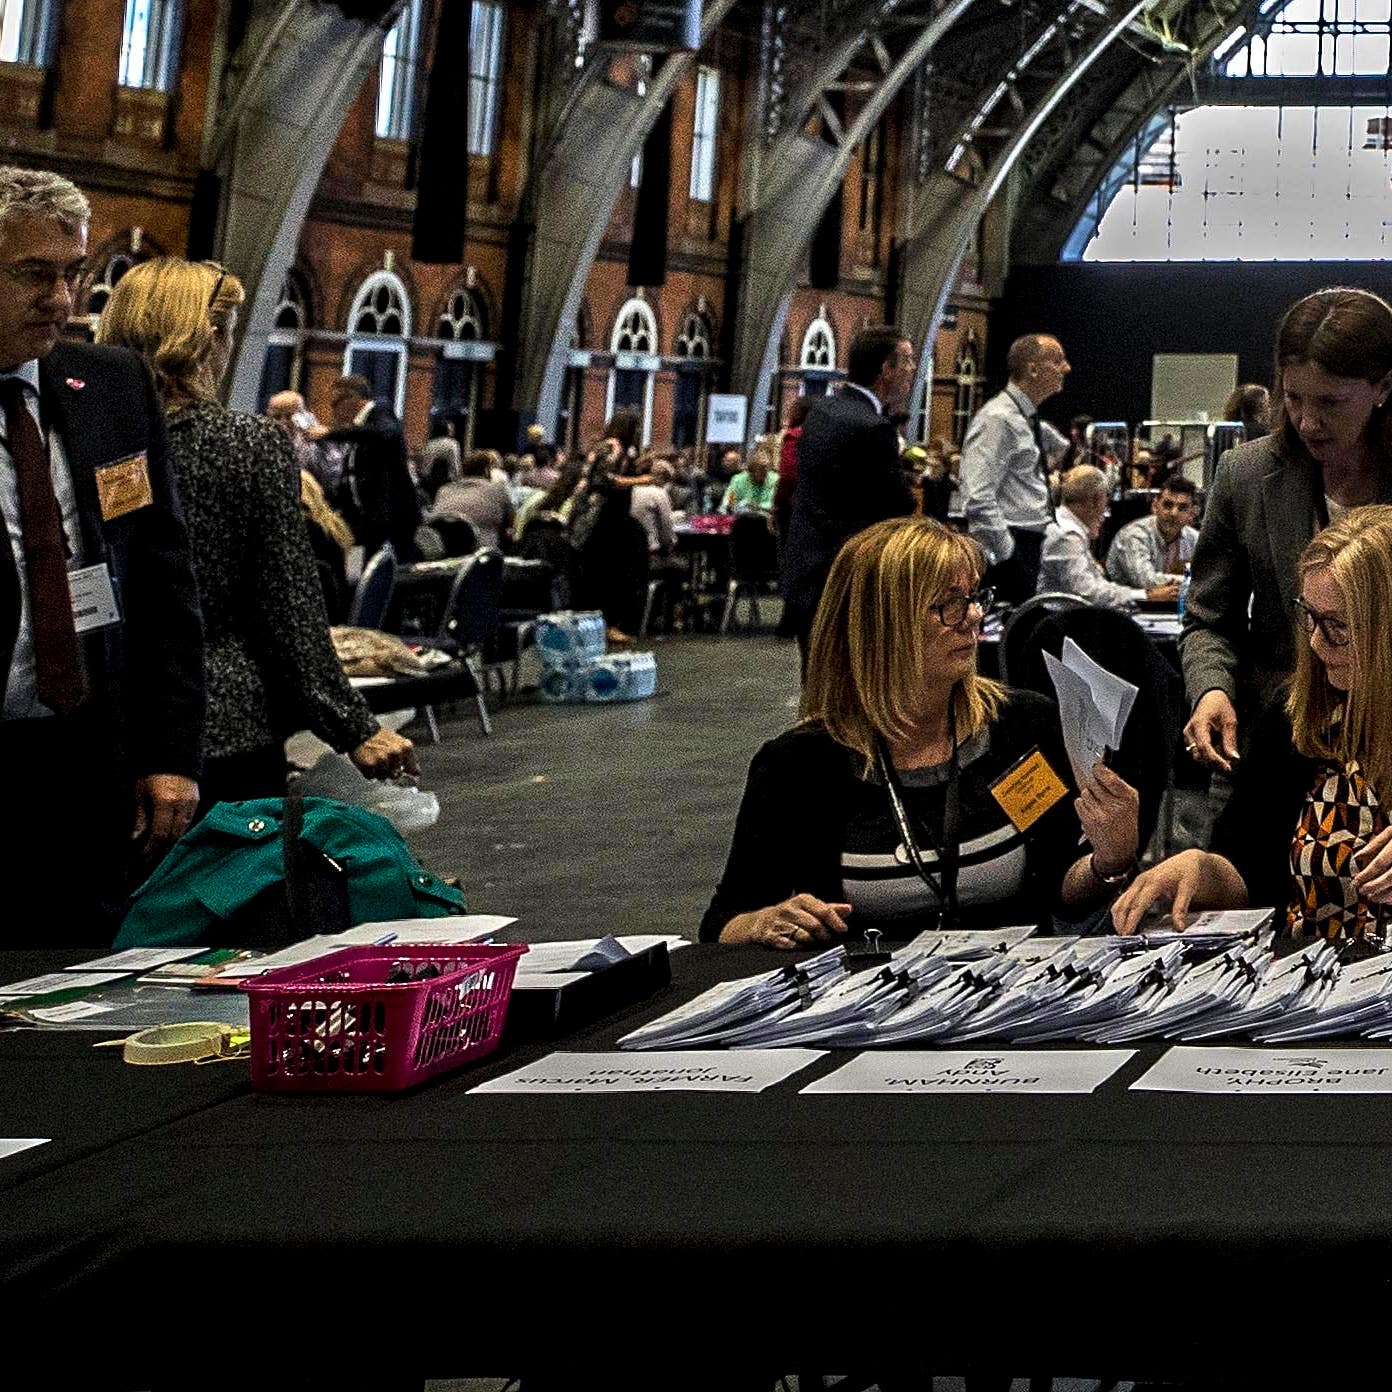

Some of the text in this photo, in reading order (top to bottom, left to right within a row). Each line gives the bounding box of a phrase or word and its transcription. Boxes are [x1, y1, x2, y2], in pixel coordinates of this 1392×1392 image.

[588, 1067, 715, 1076] Jonathan
[937, 1069, 1008, 1077] Andy
[1196, 1067, 1388, 1077] Jane Elisabeth
[515, 1077, 619, 1085] Marcus
[883, 1077, 1040, 1085] BURNHAM,
[1226, 1077, 1341, 1085] BROPHY,
